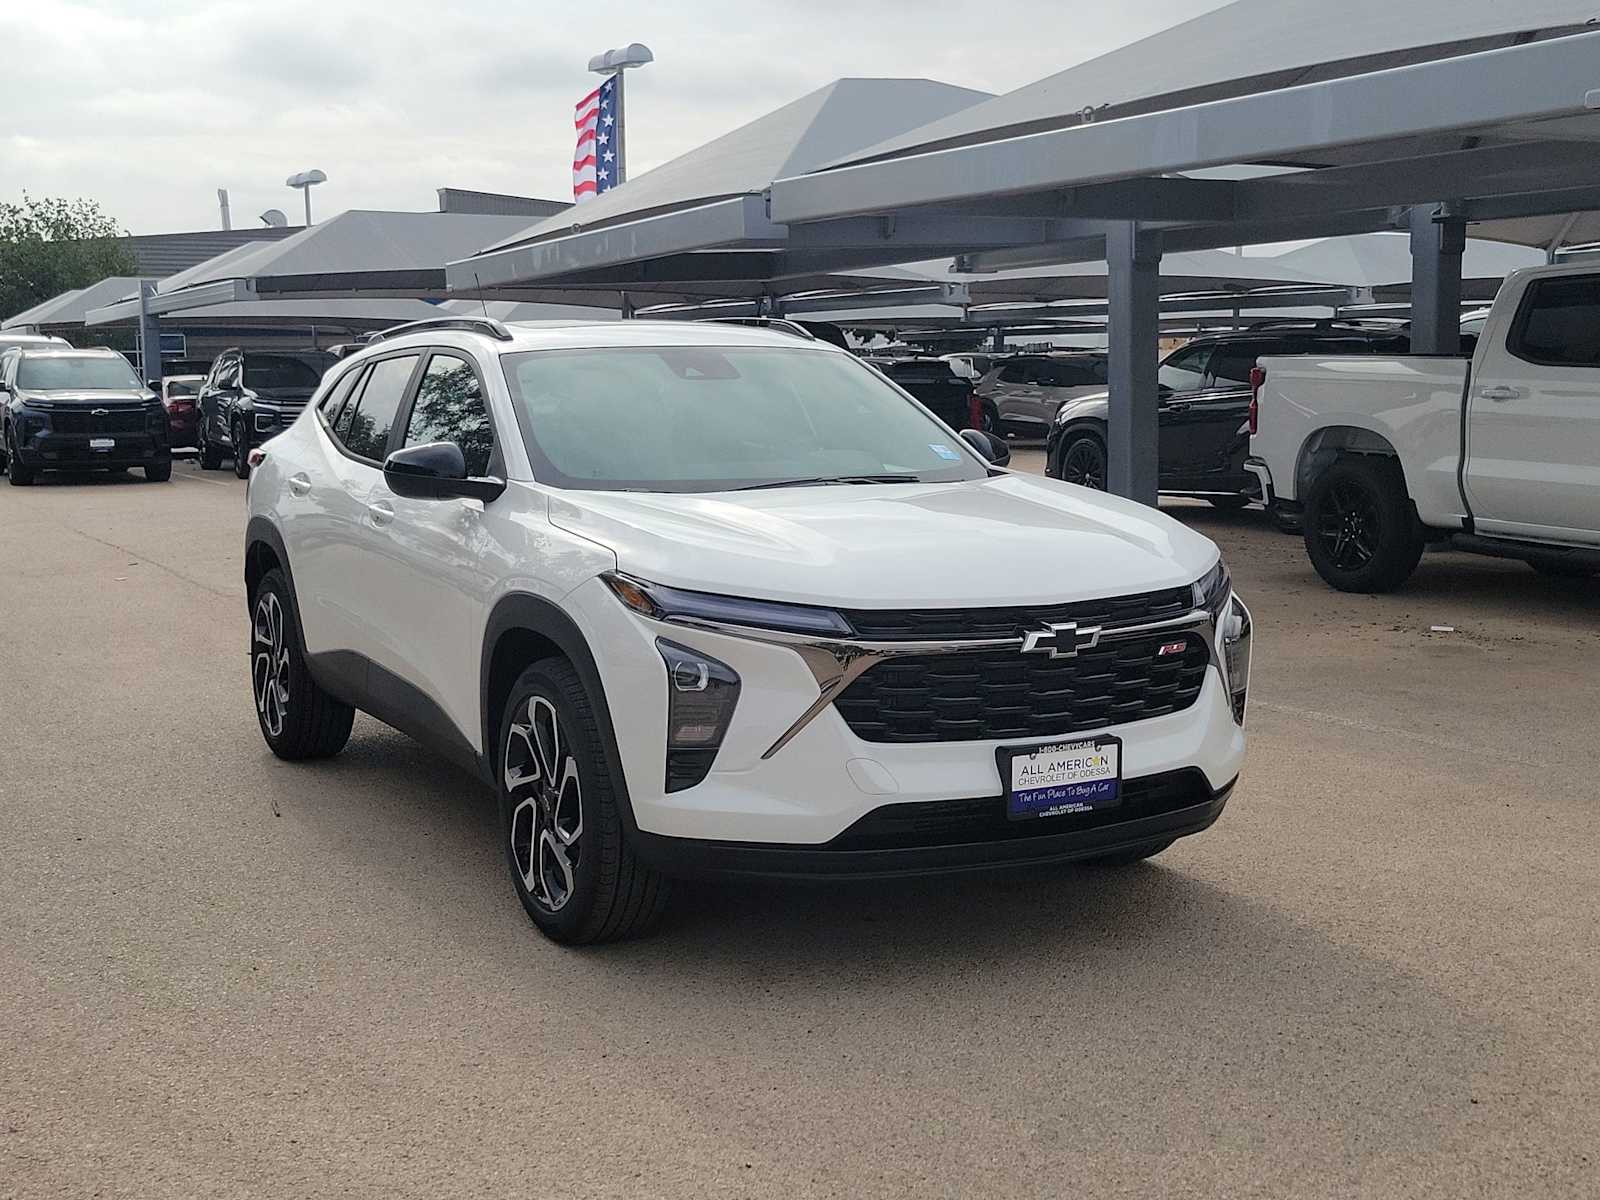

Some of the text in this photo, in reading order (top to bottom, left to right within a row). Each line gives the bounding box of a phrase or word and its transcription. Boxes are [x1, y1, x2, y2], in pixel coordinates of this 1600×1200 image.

[1018, 766, 1111, 786] CHEVROLET OF ODESSA
[1020, 764, 1044, 777] ALL
[1066, 786, 1076, 797] To
[1090, 783, 1097, 794] A
